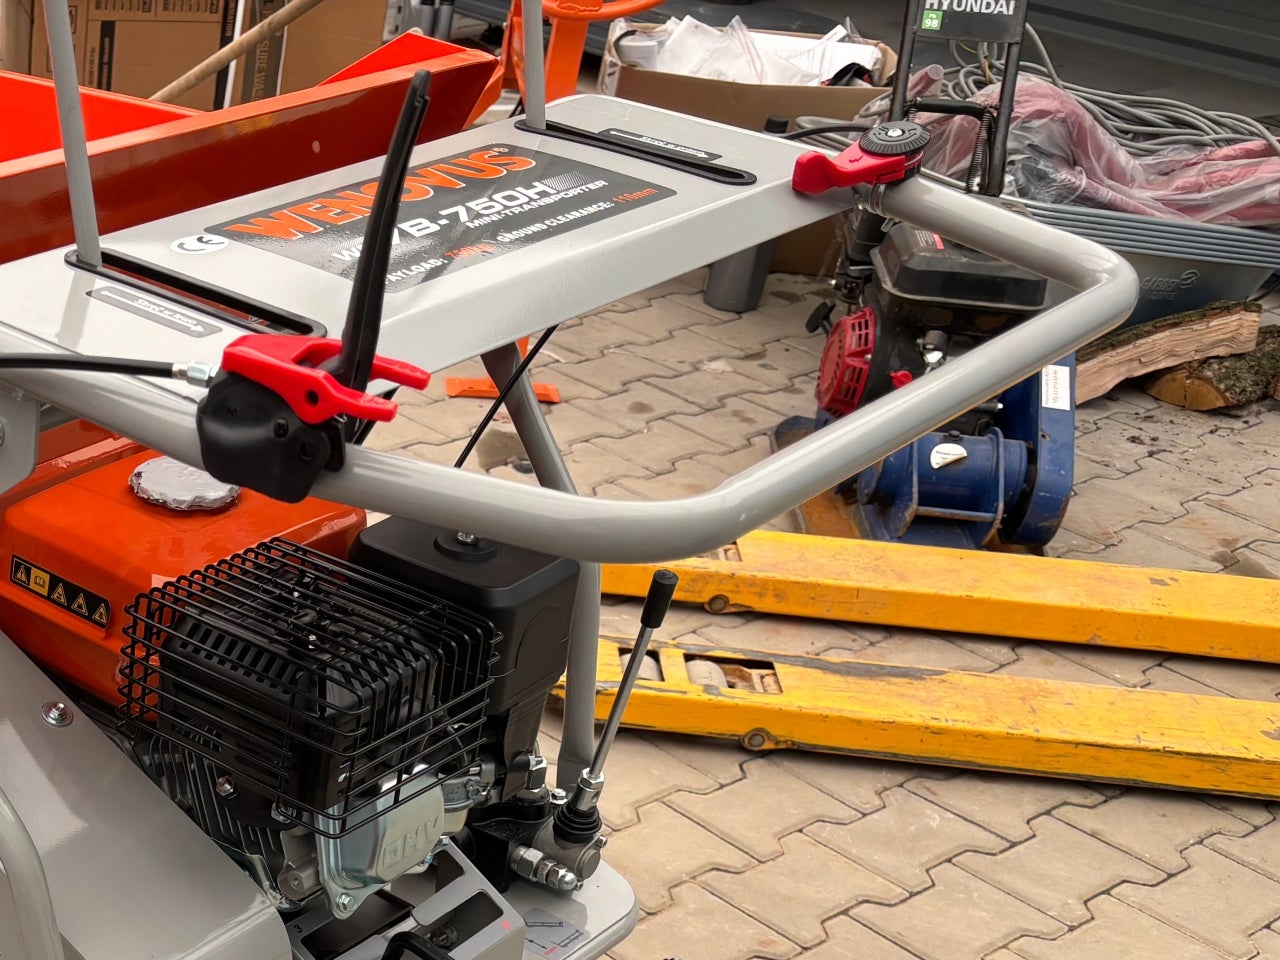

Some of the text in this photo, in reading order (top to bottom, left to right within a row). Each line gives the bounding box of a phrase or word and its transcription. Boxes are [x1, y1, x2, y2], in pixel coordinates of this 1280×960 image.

[924, 0, 1016, 15] HYUNDAI
[924, 18, 939, 28] 98
[224, 150, 537, 240] WENOVUS
[465, 179, 609, 229] MINI-TRANSPORTER
[385, 257, 449, 285] AYLOAD:
[496, 222, 550, 244] GROUND
[544, 200, 616, 227] CLEARANCE:
[293, 923, 303, 934] 3
